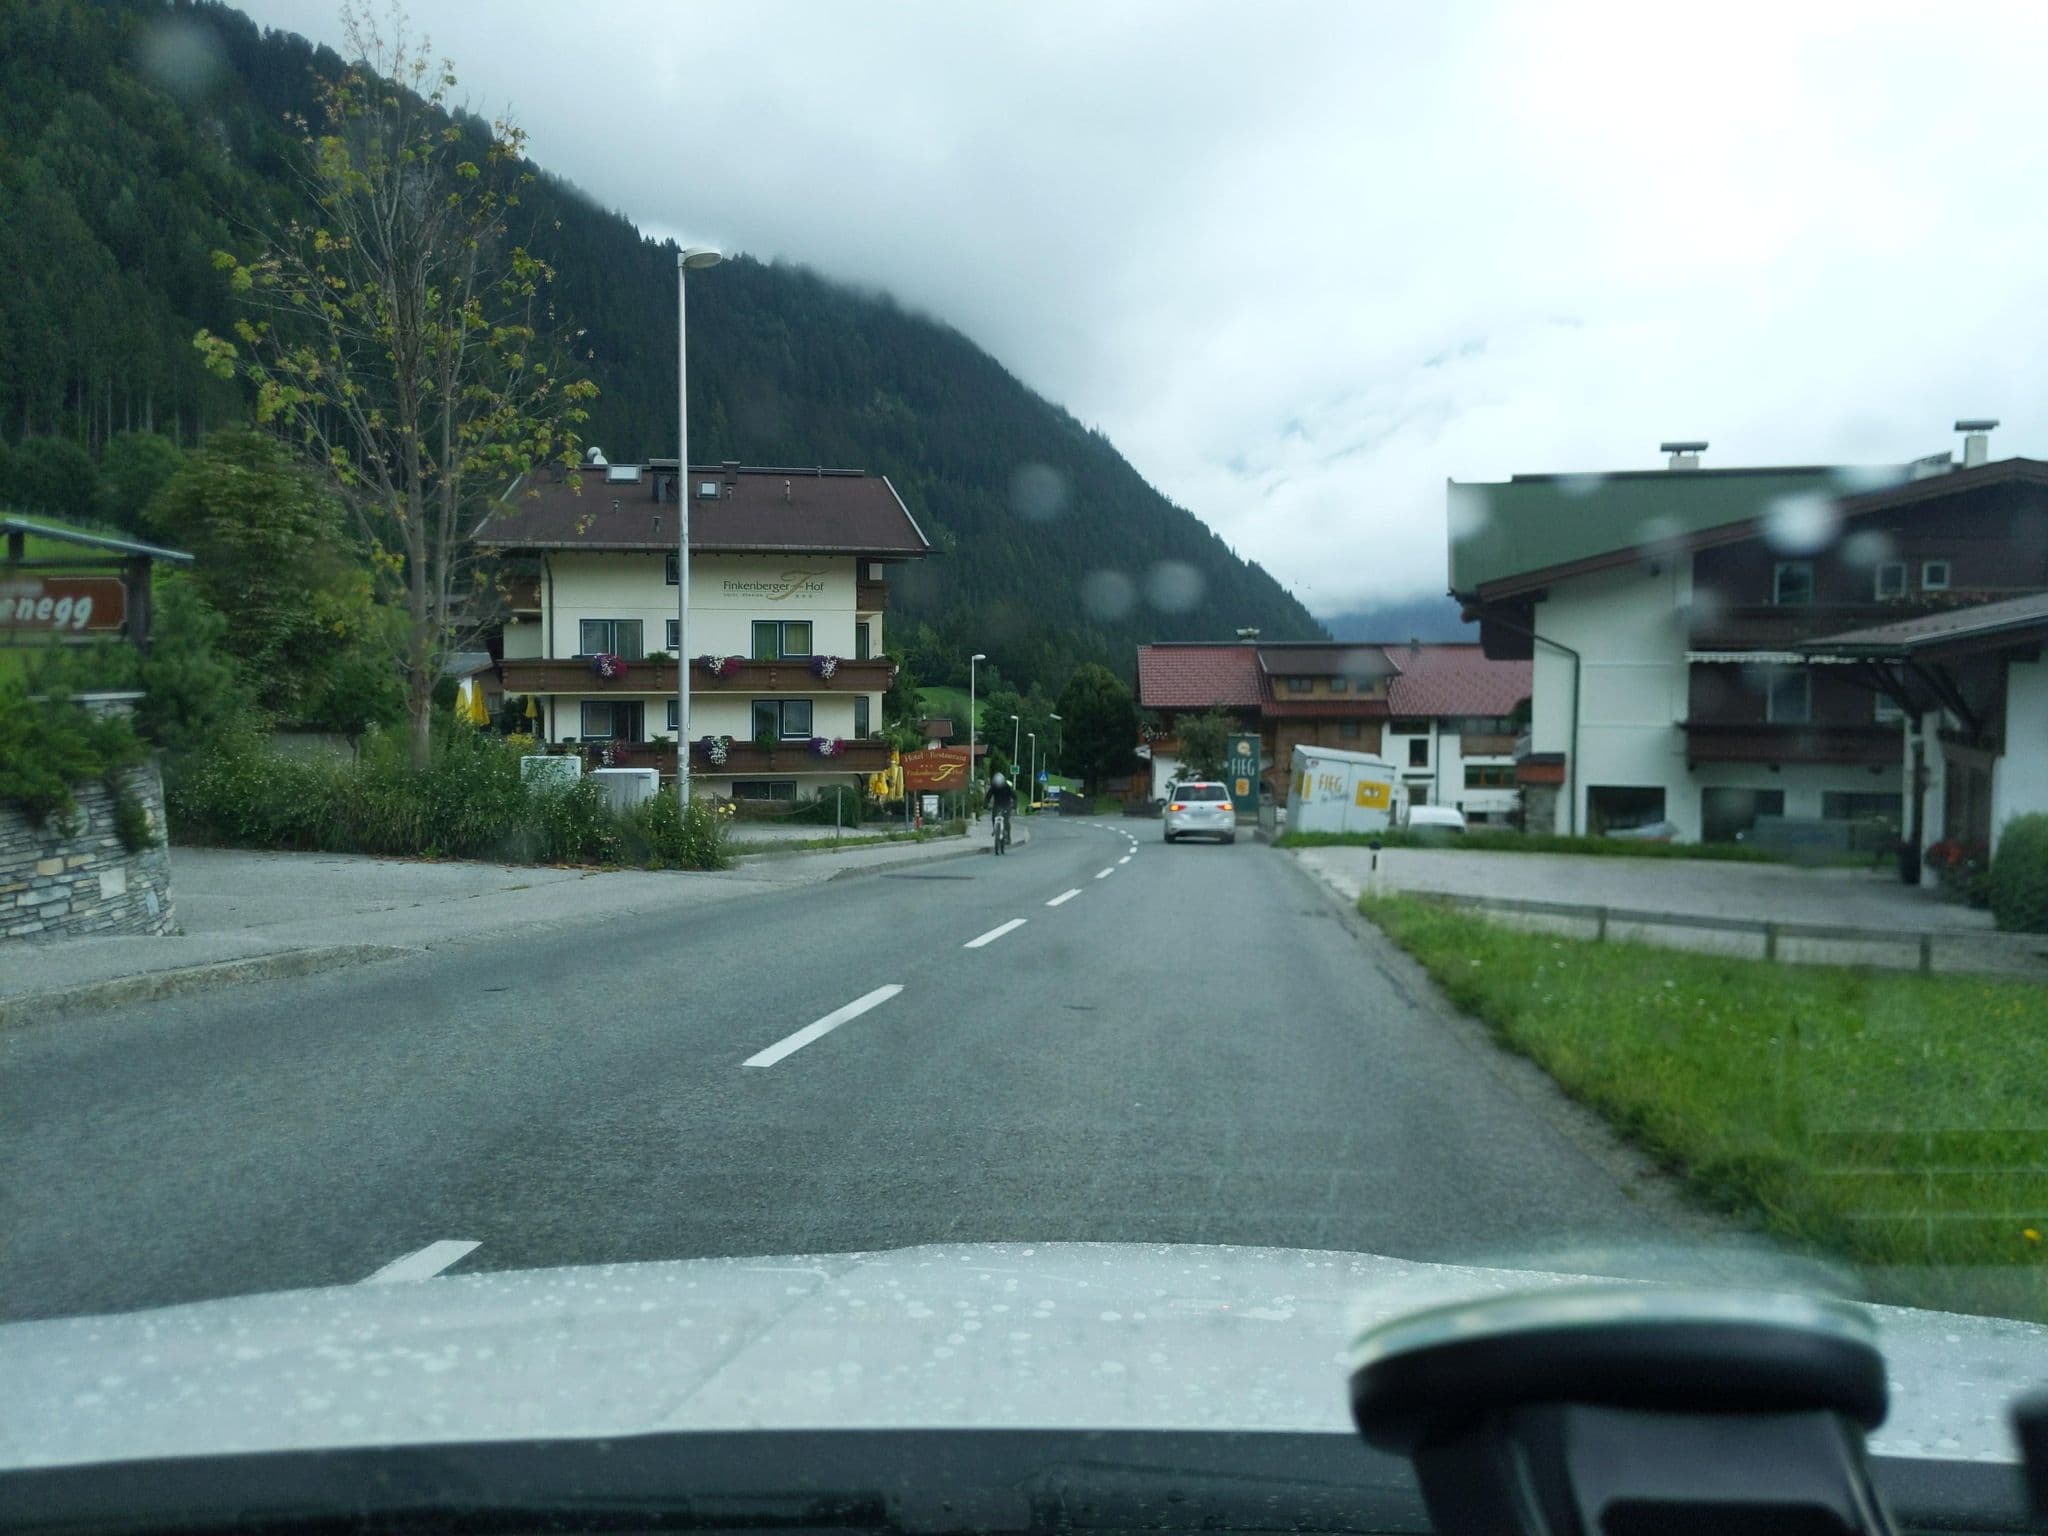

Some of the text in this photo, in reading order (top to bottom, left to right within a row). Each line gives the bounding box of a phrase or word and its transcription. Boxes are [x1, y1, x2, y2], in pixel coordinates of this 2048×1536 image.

[723, 580, 790, 593] Finkenberger
[805, 581, 825, 592] Hof
[904, 751, 967, 763] Hotel Restaurant
[1231, 758, 1255, 777] FIEG
[1318, 772, 1343, 793] FIEG
